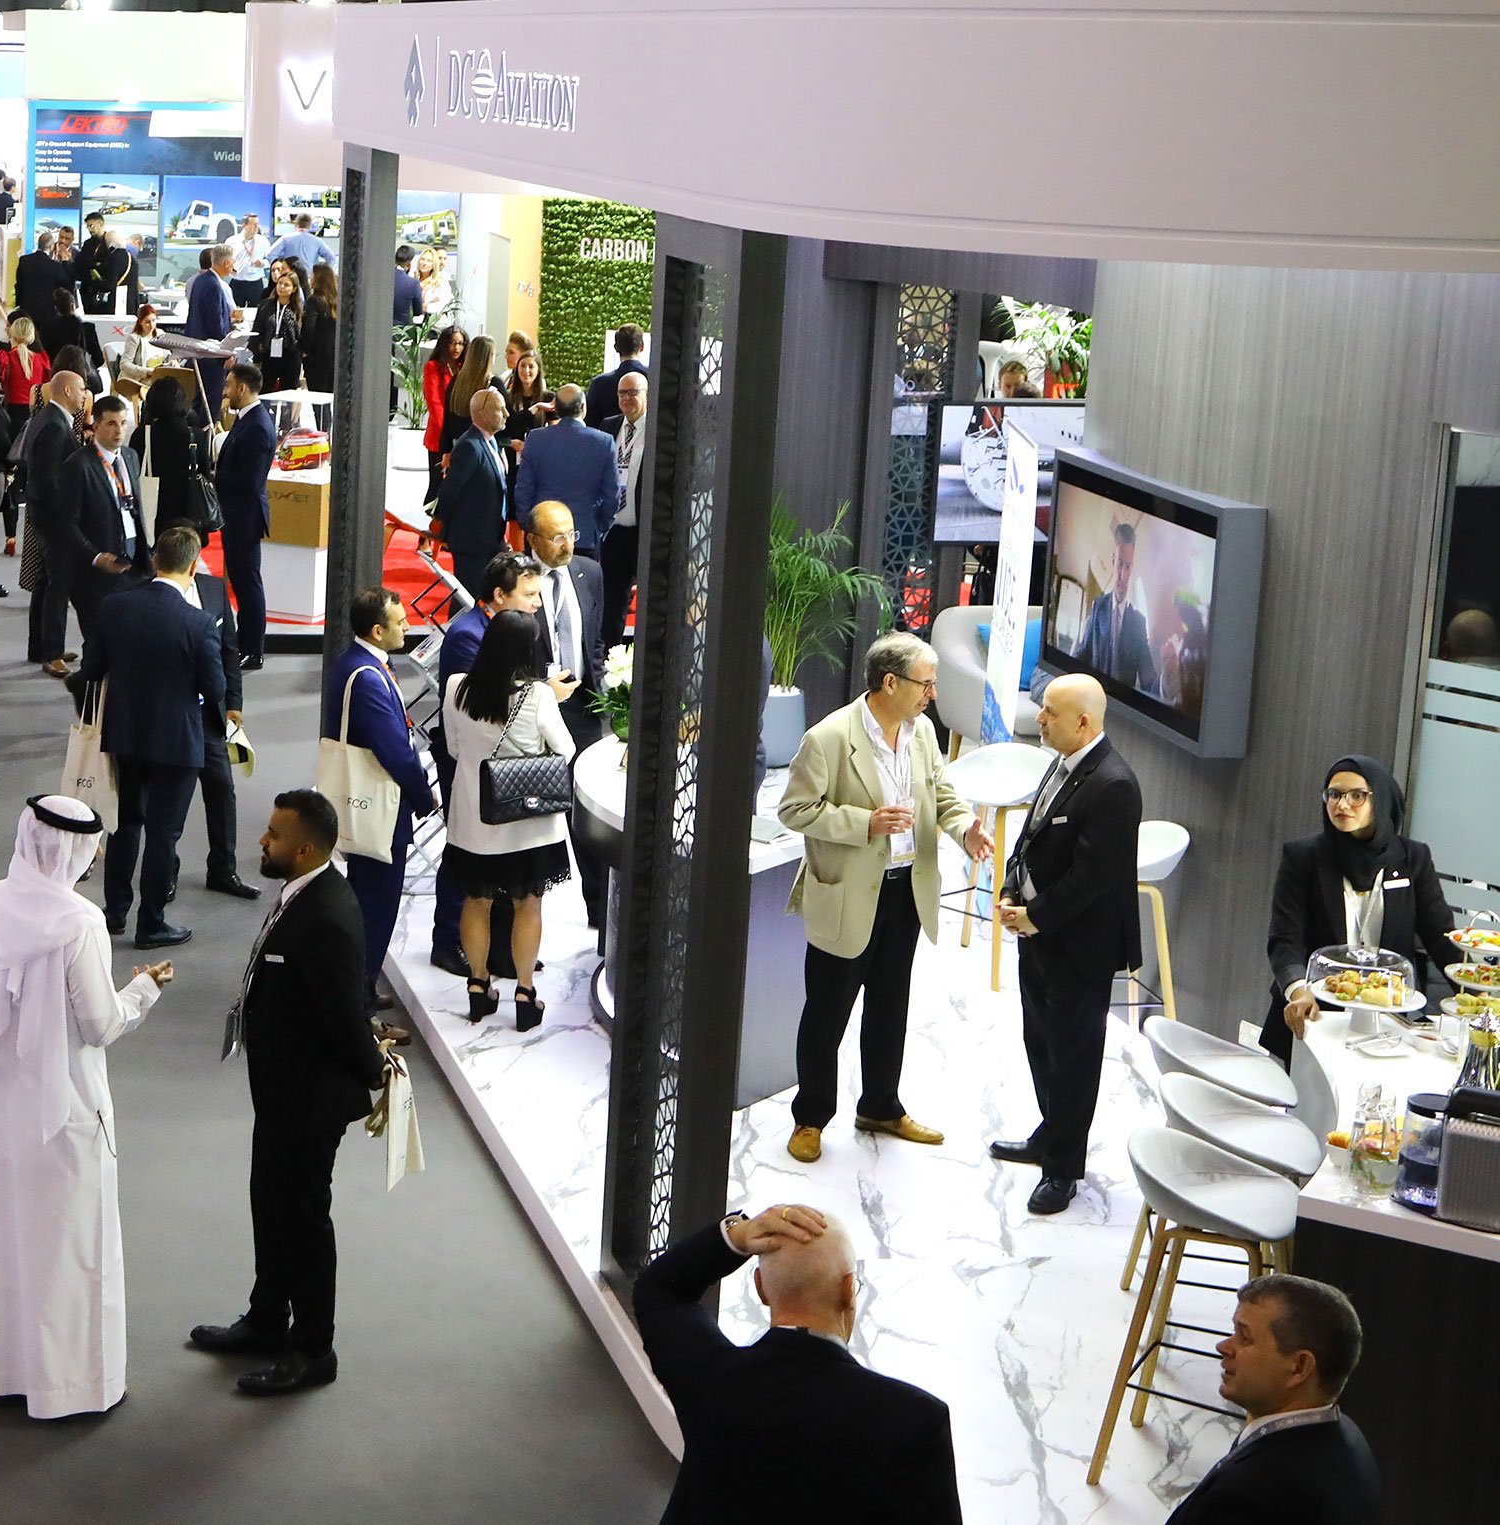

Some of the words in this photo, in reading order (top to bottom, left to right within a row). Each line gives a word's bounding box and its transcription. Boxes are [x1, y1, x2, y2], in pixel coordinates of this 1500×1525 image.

[446, 49, 475, 120] DC
[60, 115, 129, 134] LEKTRO
[214, 151, 240, 162] Wide
[580, 237, 648, 264] CARBON
[76, 778, 92, 788] FCG
[347, 797, 368, 809] FCG
